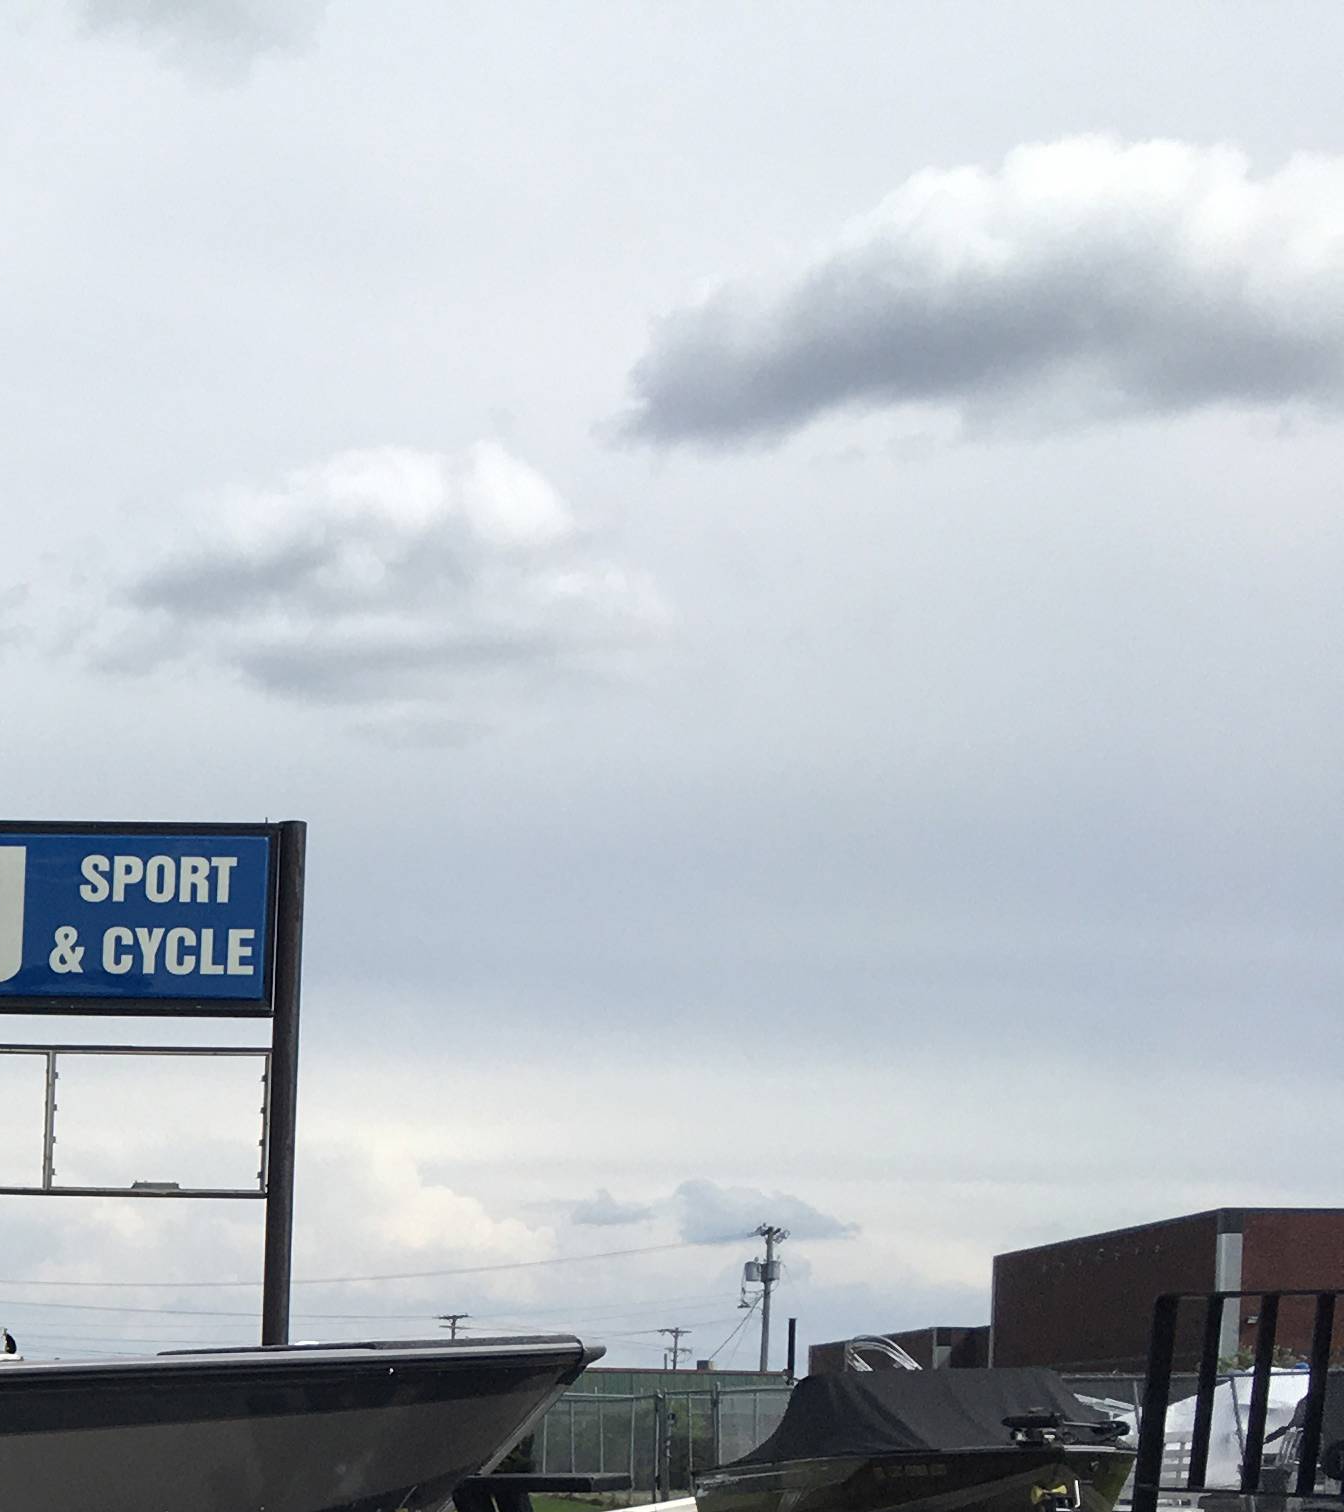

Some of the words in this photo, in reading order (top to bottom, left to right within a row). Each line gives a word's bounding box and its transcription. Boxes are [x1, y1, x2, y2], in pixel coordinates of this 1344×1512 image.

[79, 854, 238, 904] SPORT
[48, 925, 85, 975] &
[102, 926, 255, 976] CYCLE
